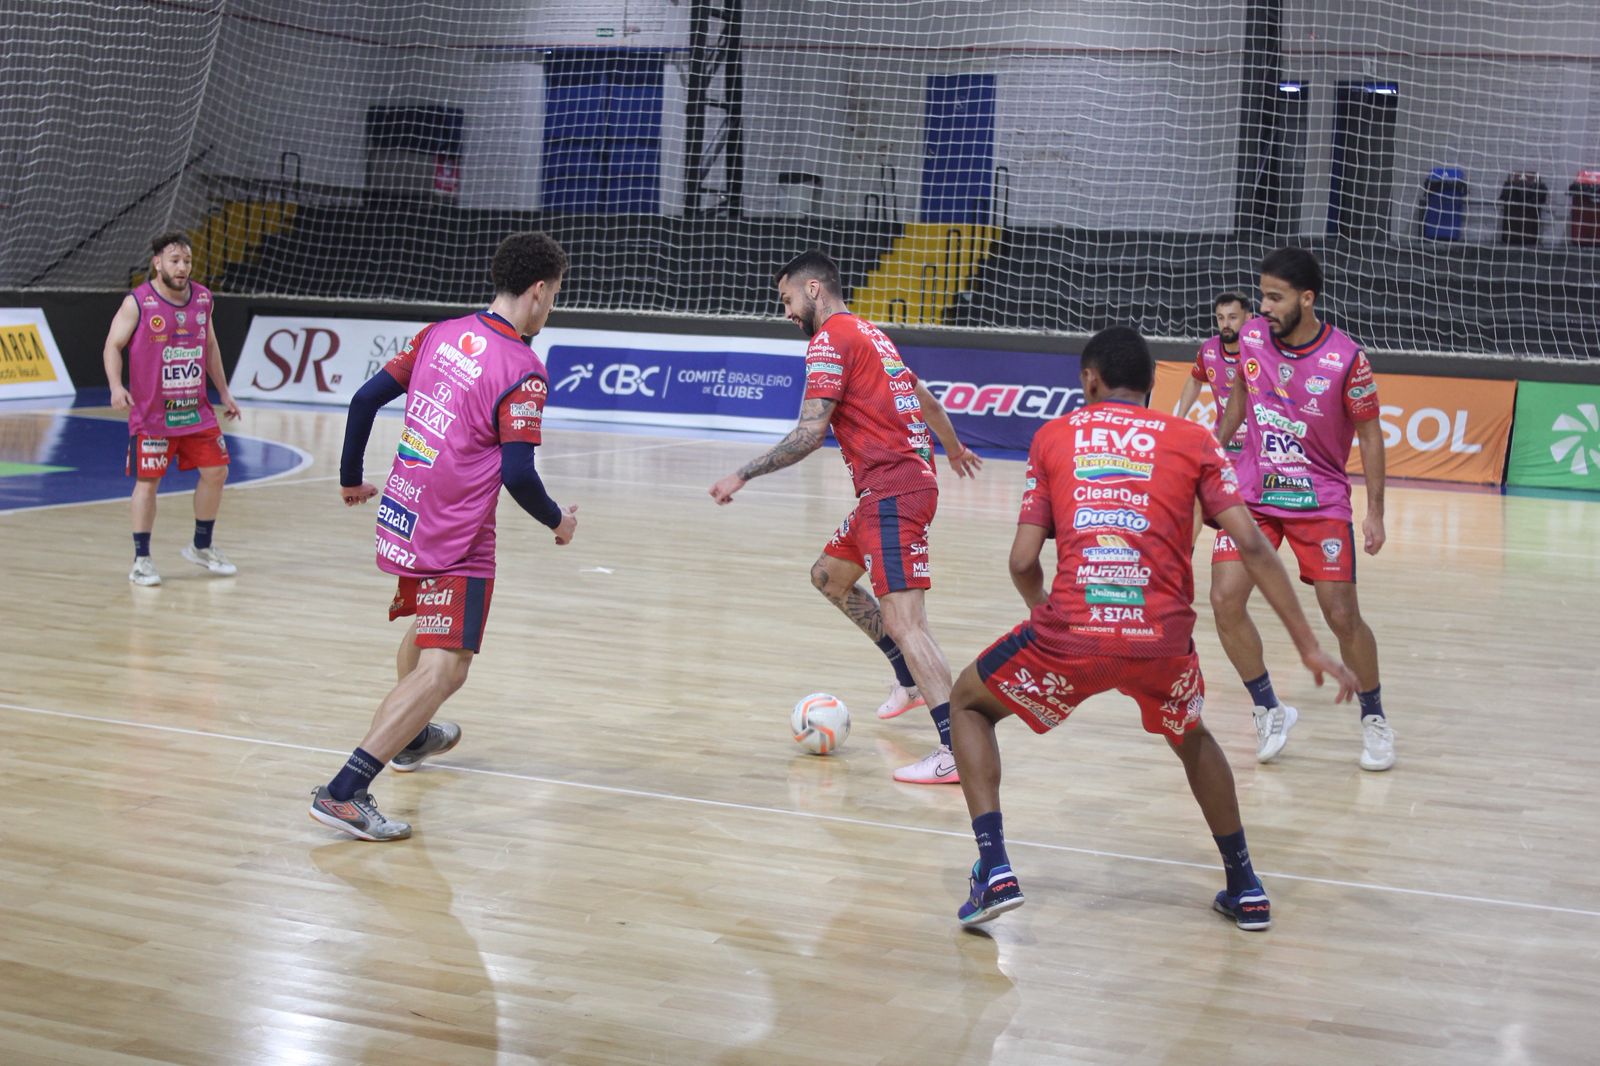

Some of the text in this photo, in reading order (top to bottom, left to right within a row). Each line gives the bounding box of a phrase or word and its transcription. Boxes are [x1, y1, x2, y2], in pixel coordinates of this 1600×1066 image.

[0, 330, 45, 362] ARCA
[164, 362, 200, 380] LEVO
[251, 328, 340, 393] SR
[600, 363, 660, 397] CBC
[677, 368, 726, 384] COMITÊ
[727, 371, 793, 388] BRASILEIRO
[713, 384, 764, 400] CLUBES
[1091, 411, 1166, 432] Sicredi
[1354, 405, 1482, 454] SOL
[1074, 427, 1156, 452] LEVO
[1074, 446, 1155, 459] ALIMENTOS
[1073, 486, 1150, 507] ClearDet
[1074, 508, 1149, 531] Duetto
[1077, 563, 1152, 578] MUFFATÃO
[1103, 607, 1145, 623] STAR
